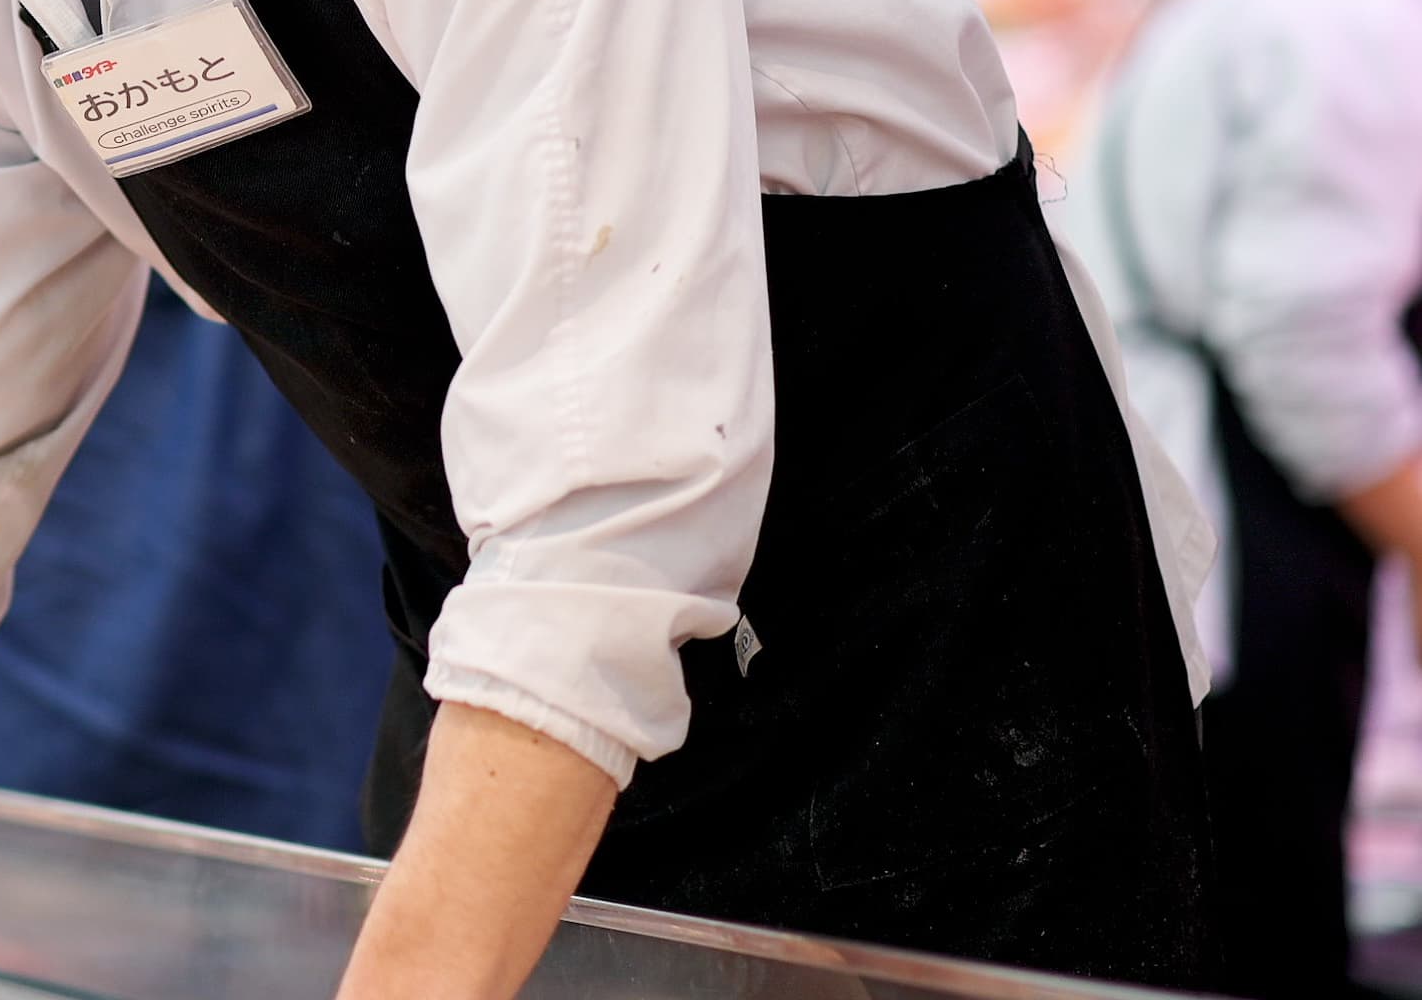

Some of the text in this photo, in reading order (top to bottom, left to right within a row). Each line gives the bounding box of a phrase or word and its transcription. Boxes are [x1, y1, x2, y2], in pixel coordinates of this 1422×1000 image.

[78, 57, 235, 122] おかもと
[113, 96, 240, 144] challenge spirits
